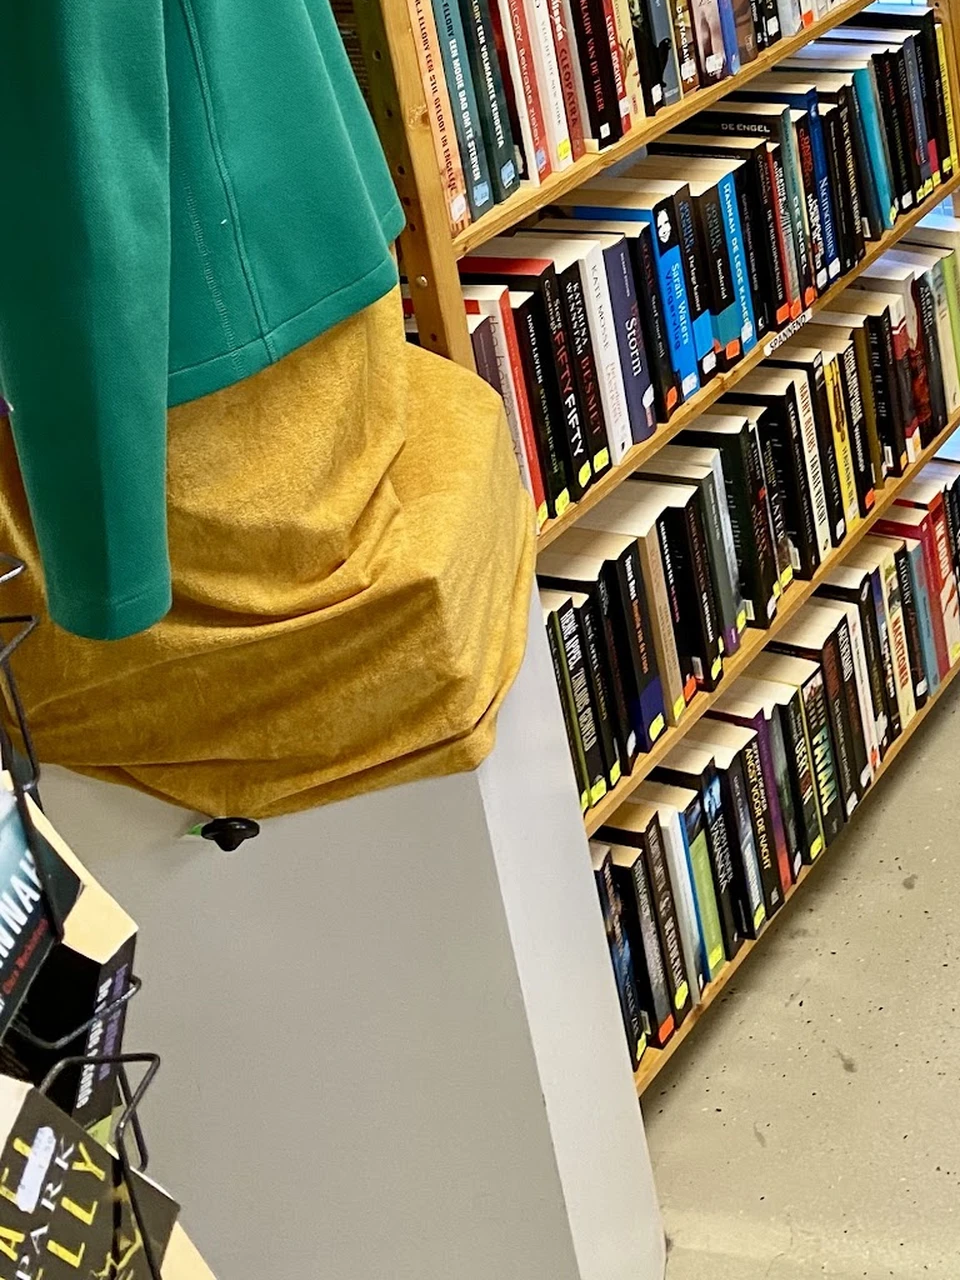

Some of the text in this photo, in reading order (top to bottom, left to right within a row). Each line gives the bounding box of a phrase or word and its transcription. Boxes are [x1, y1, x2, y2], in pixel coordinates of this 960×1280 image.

[489, 101, 504, 149] VENDETTA
[721, 123, 770, 133] DE ENGEL
[671, 262, 683, 300] Sarah
[625, 316, 642, 377] Storm
[565, 394, 584, 457] FIFTY
[745, 748, 757, 784] ANGST
[750, 783, 763, 819] VOOR
[759, 834, 772, 870] NACHT
